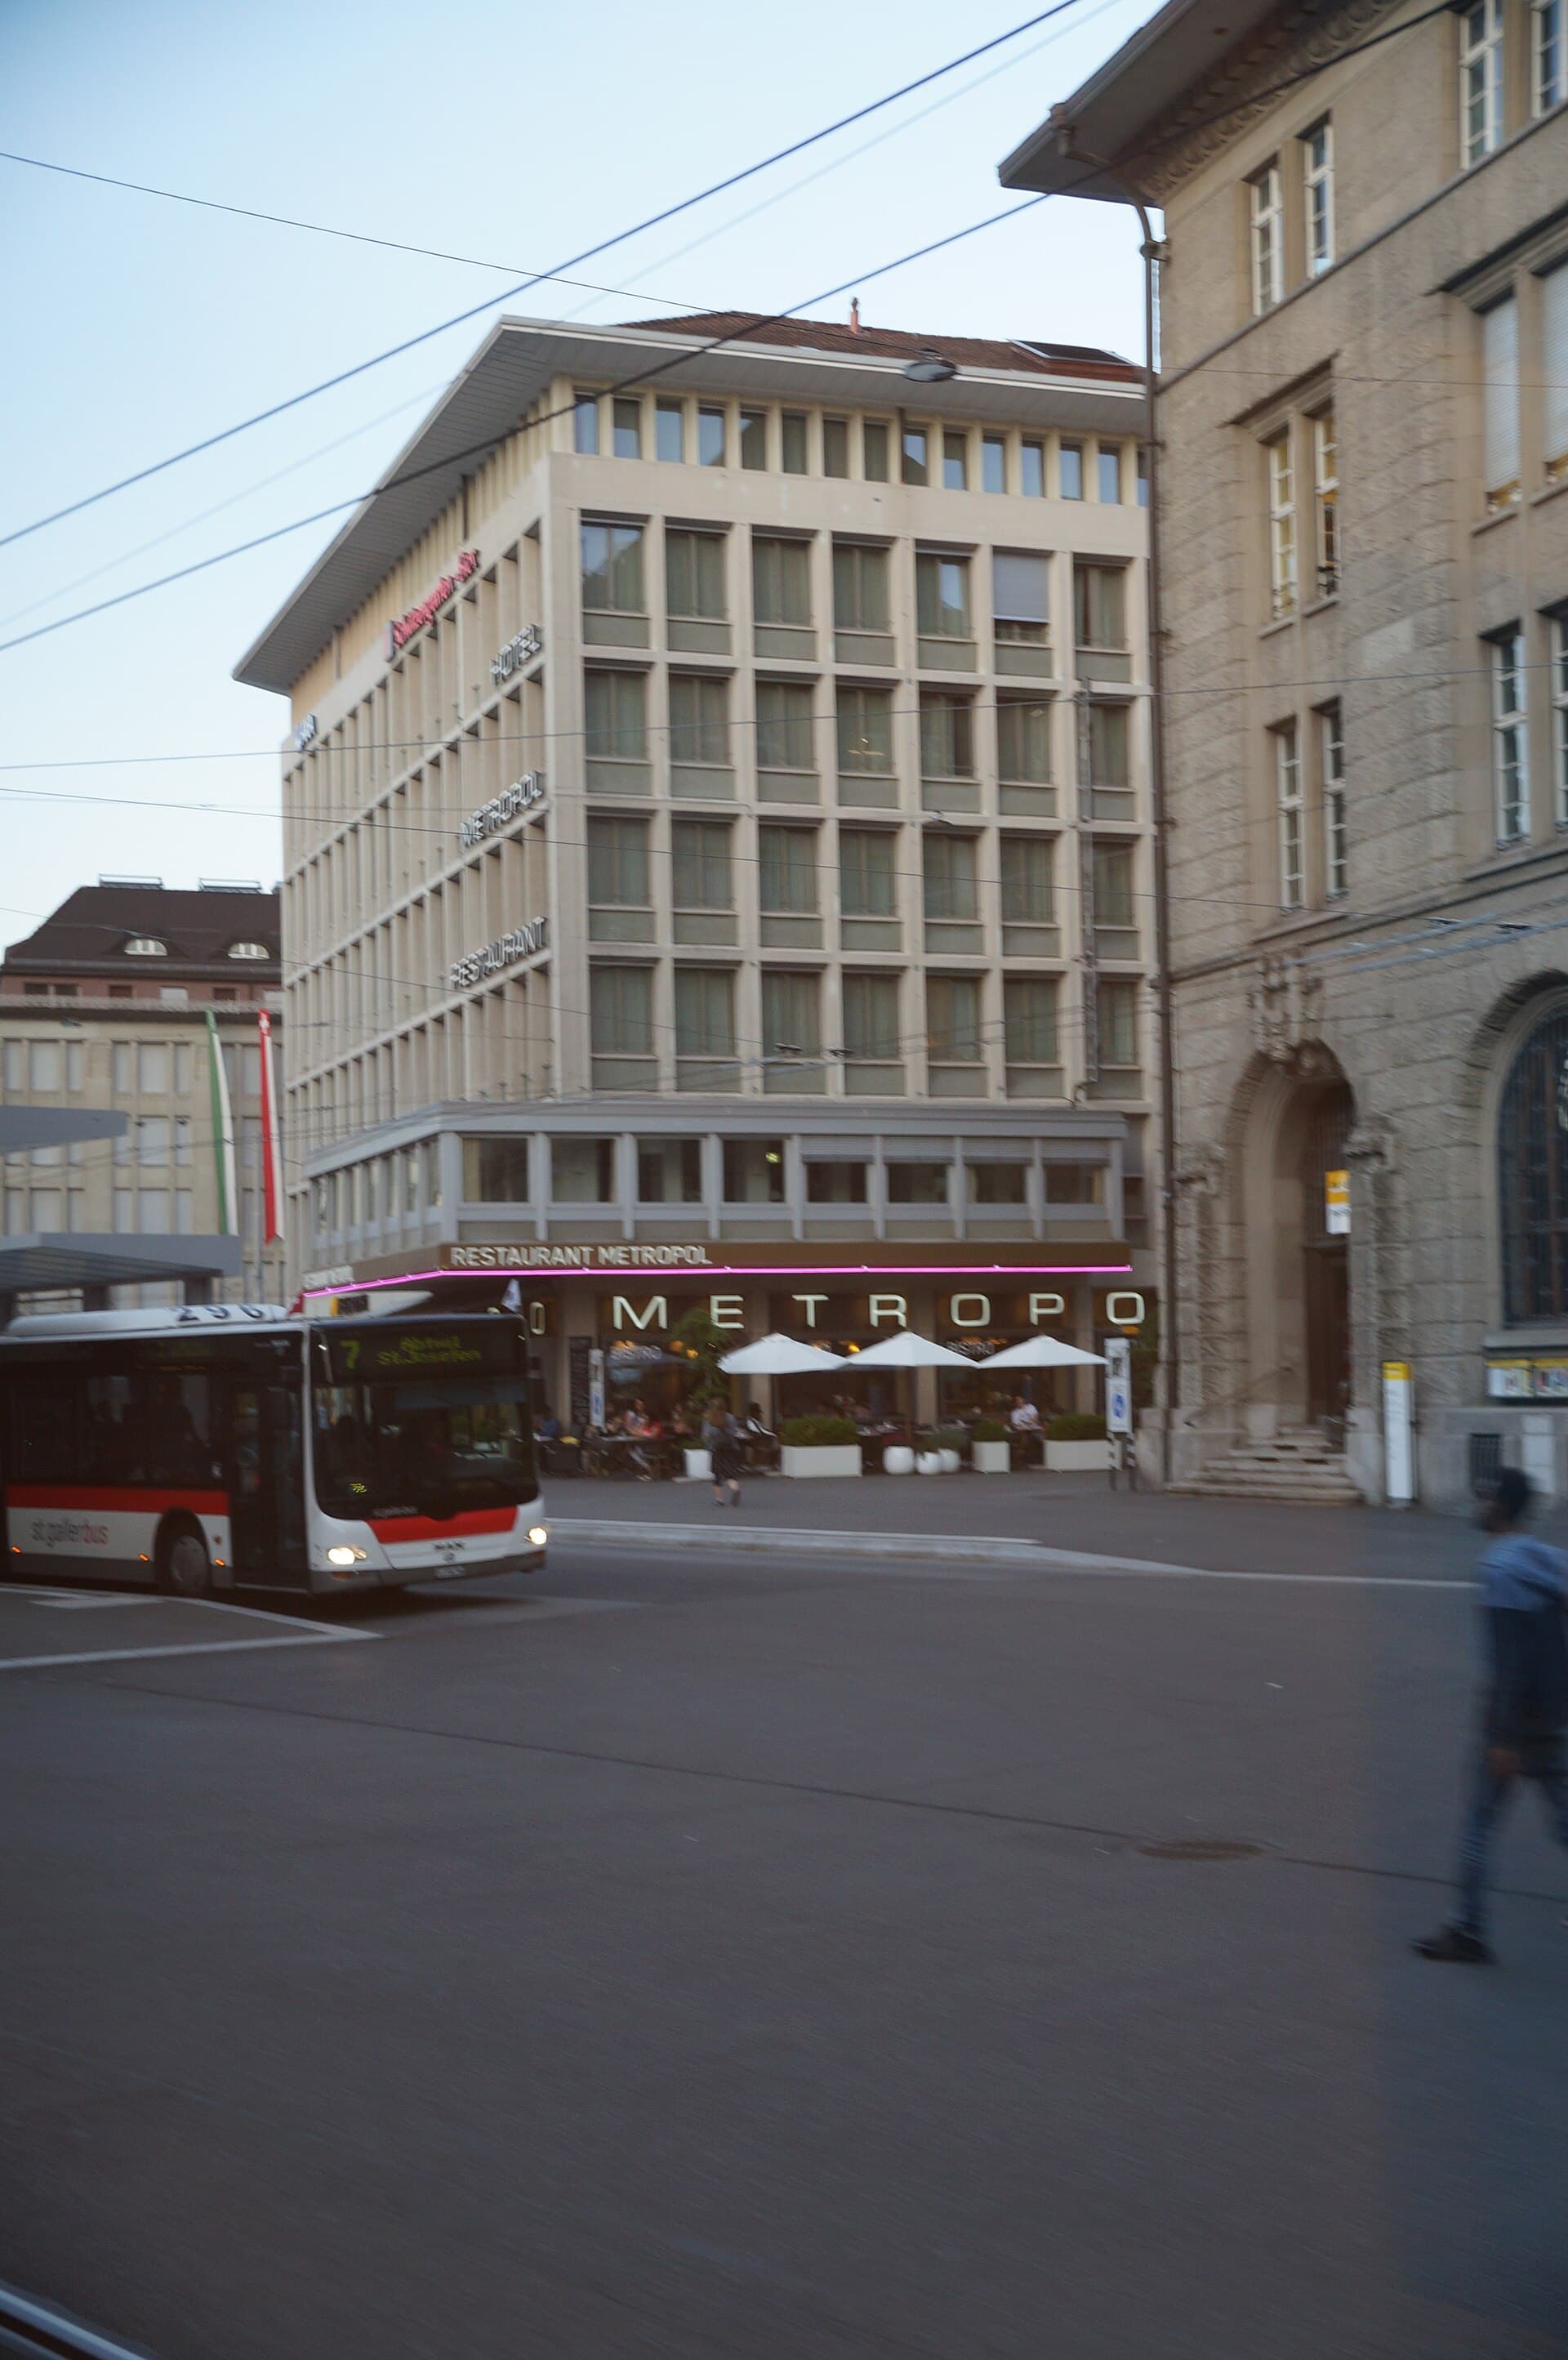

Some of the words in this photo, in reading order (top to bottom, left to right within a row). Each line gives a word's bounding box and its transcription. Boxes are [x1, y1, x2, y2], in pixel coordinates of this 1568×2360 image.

[490, 624, 541, 686] HOTEL
[460, 771, 543, 846] METROPOL
[449, 916, 545, 988] RESTAURANT
[451, 1246, 595, 1266] RESTAURANT
[597, 1245, 713, 1265] METROPOL
[340, 1340, 360, 1369] 7
